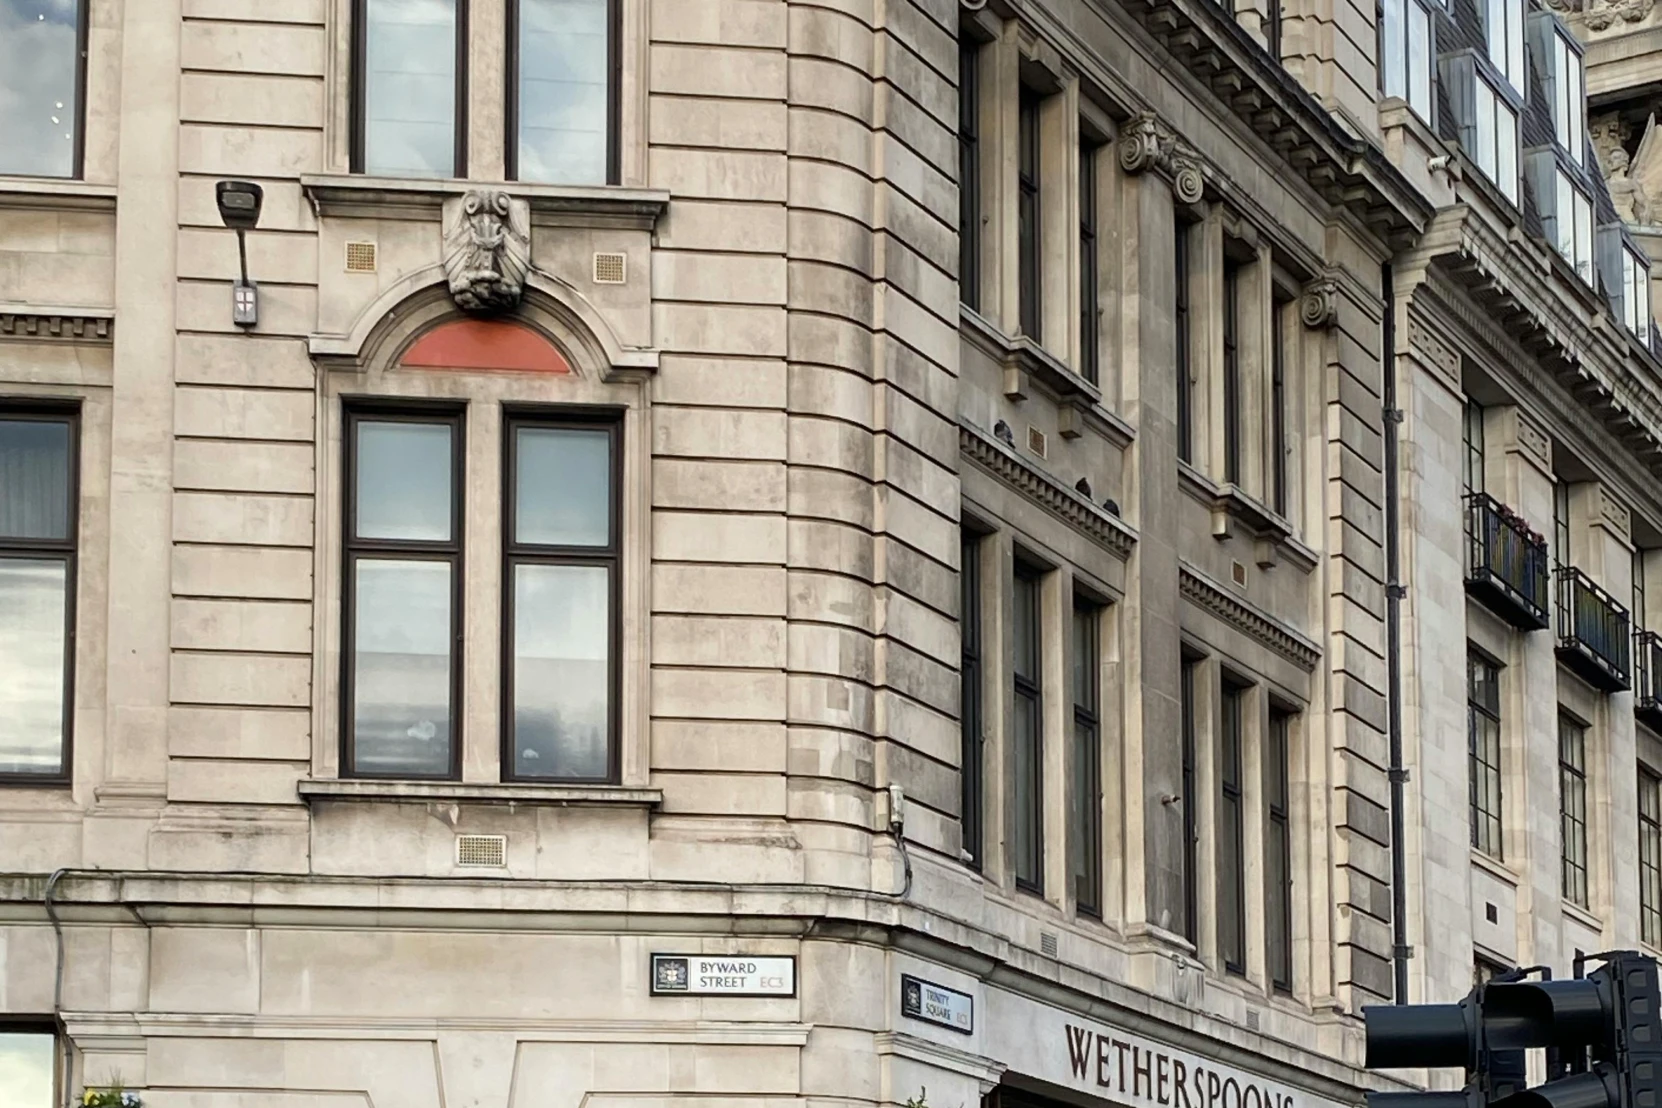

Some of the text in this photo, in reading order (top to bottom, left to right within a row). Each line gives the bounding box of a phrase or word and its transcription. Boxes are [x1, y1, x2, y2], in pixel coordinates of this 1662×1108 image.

[700, 962, 756, 973] BYWARD
[700, 976, 784, 988] STREET EC3
[926, 989, 950, 1006] TRINITY
[926, 1003, 951, 1021] SQUARE
